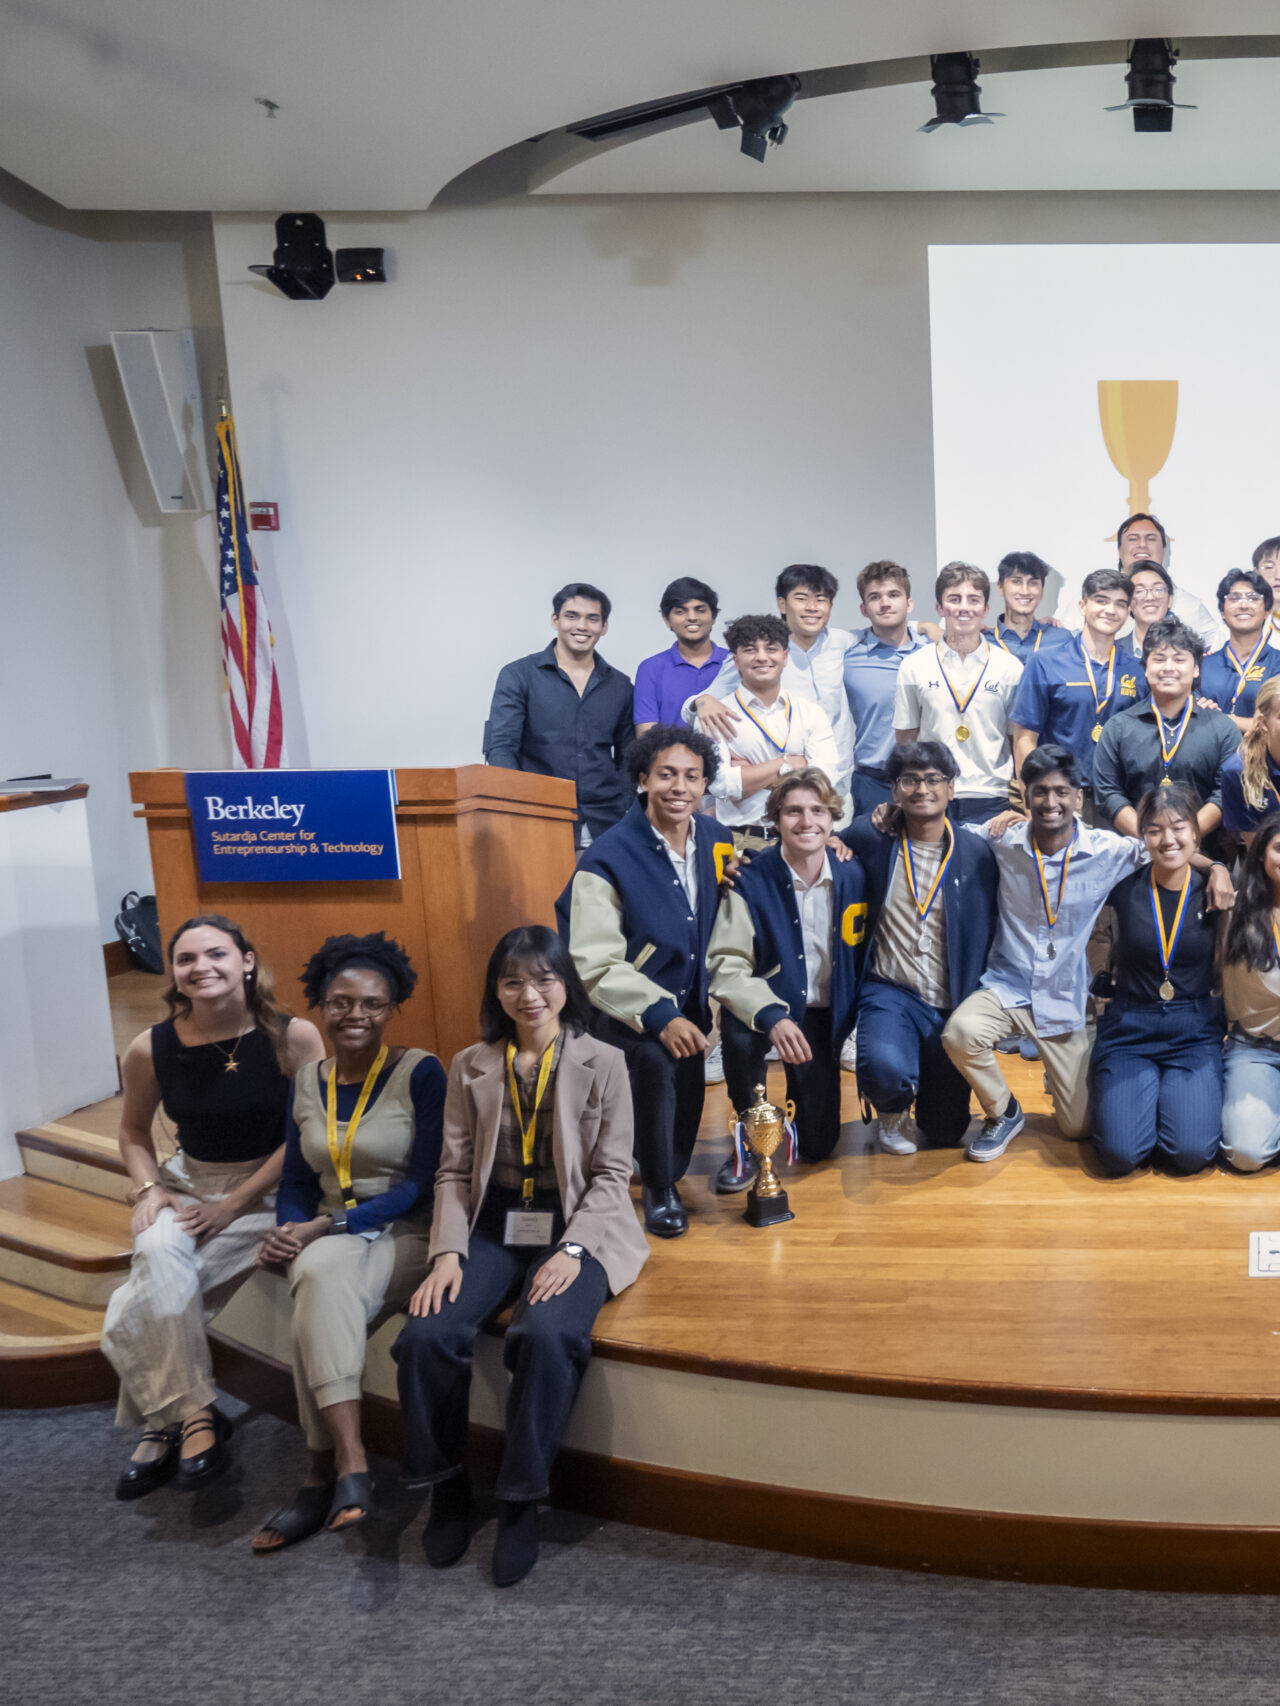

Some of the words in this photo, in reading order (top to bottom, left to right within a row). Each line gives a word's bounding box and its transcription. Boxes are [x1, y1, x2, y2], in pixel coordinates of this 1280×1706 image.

[1120, 674, 1136, 688] Cal
[204, 796, 305, 826] Berkeley
[211, 830, 258, 844] Sutardja
[259, 830, 296, 842] Center
[299, 829, 316, 841] for
[213, 843, 308, 857] Entrepreneurship
[309, 842, 320, 853] &
[321, 841, 384, 856] Technology
